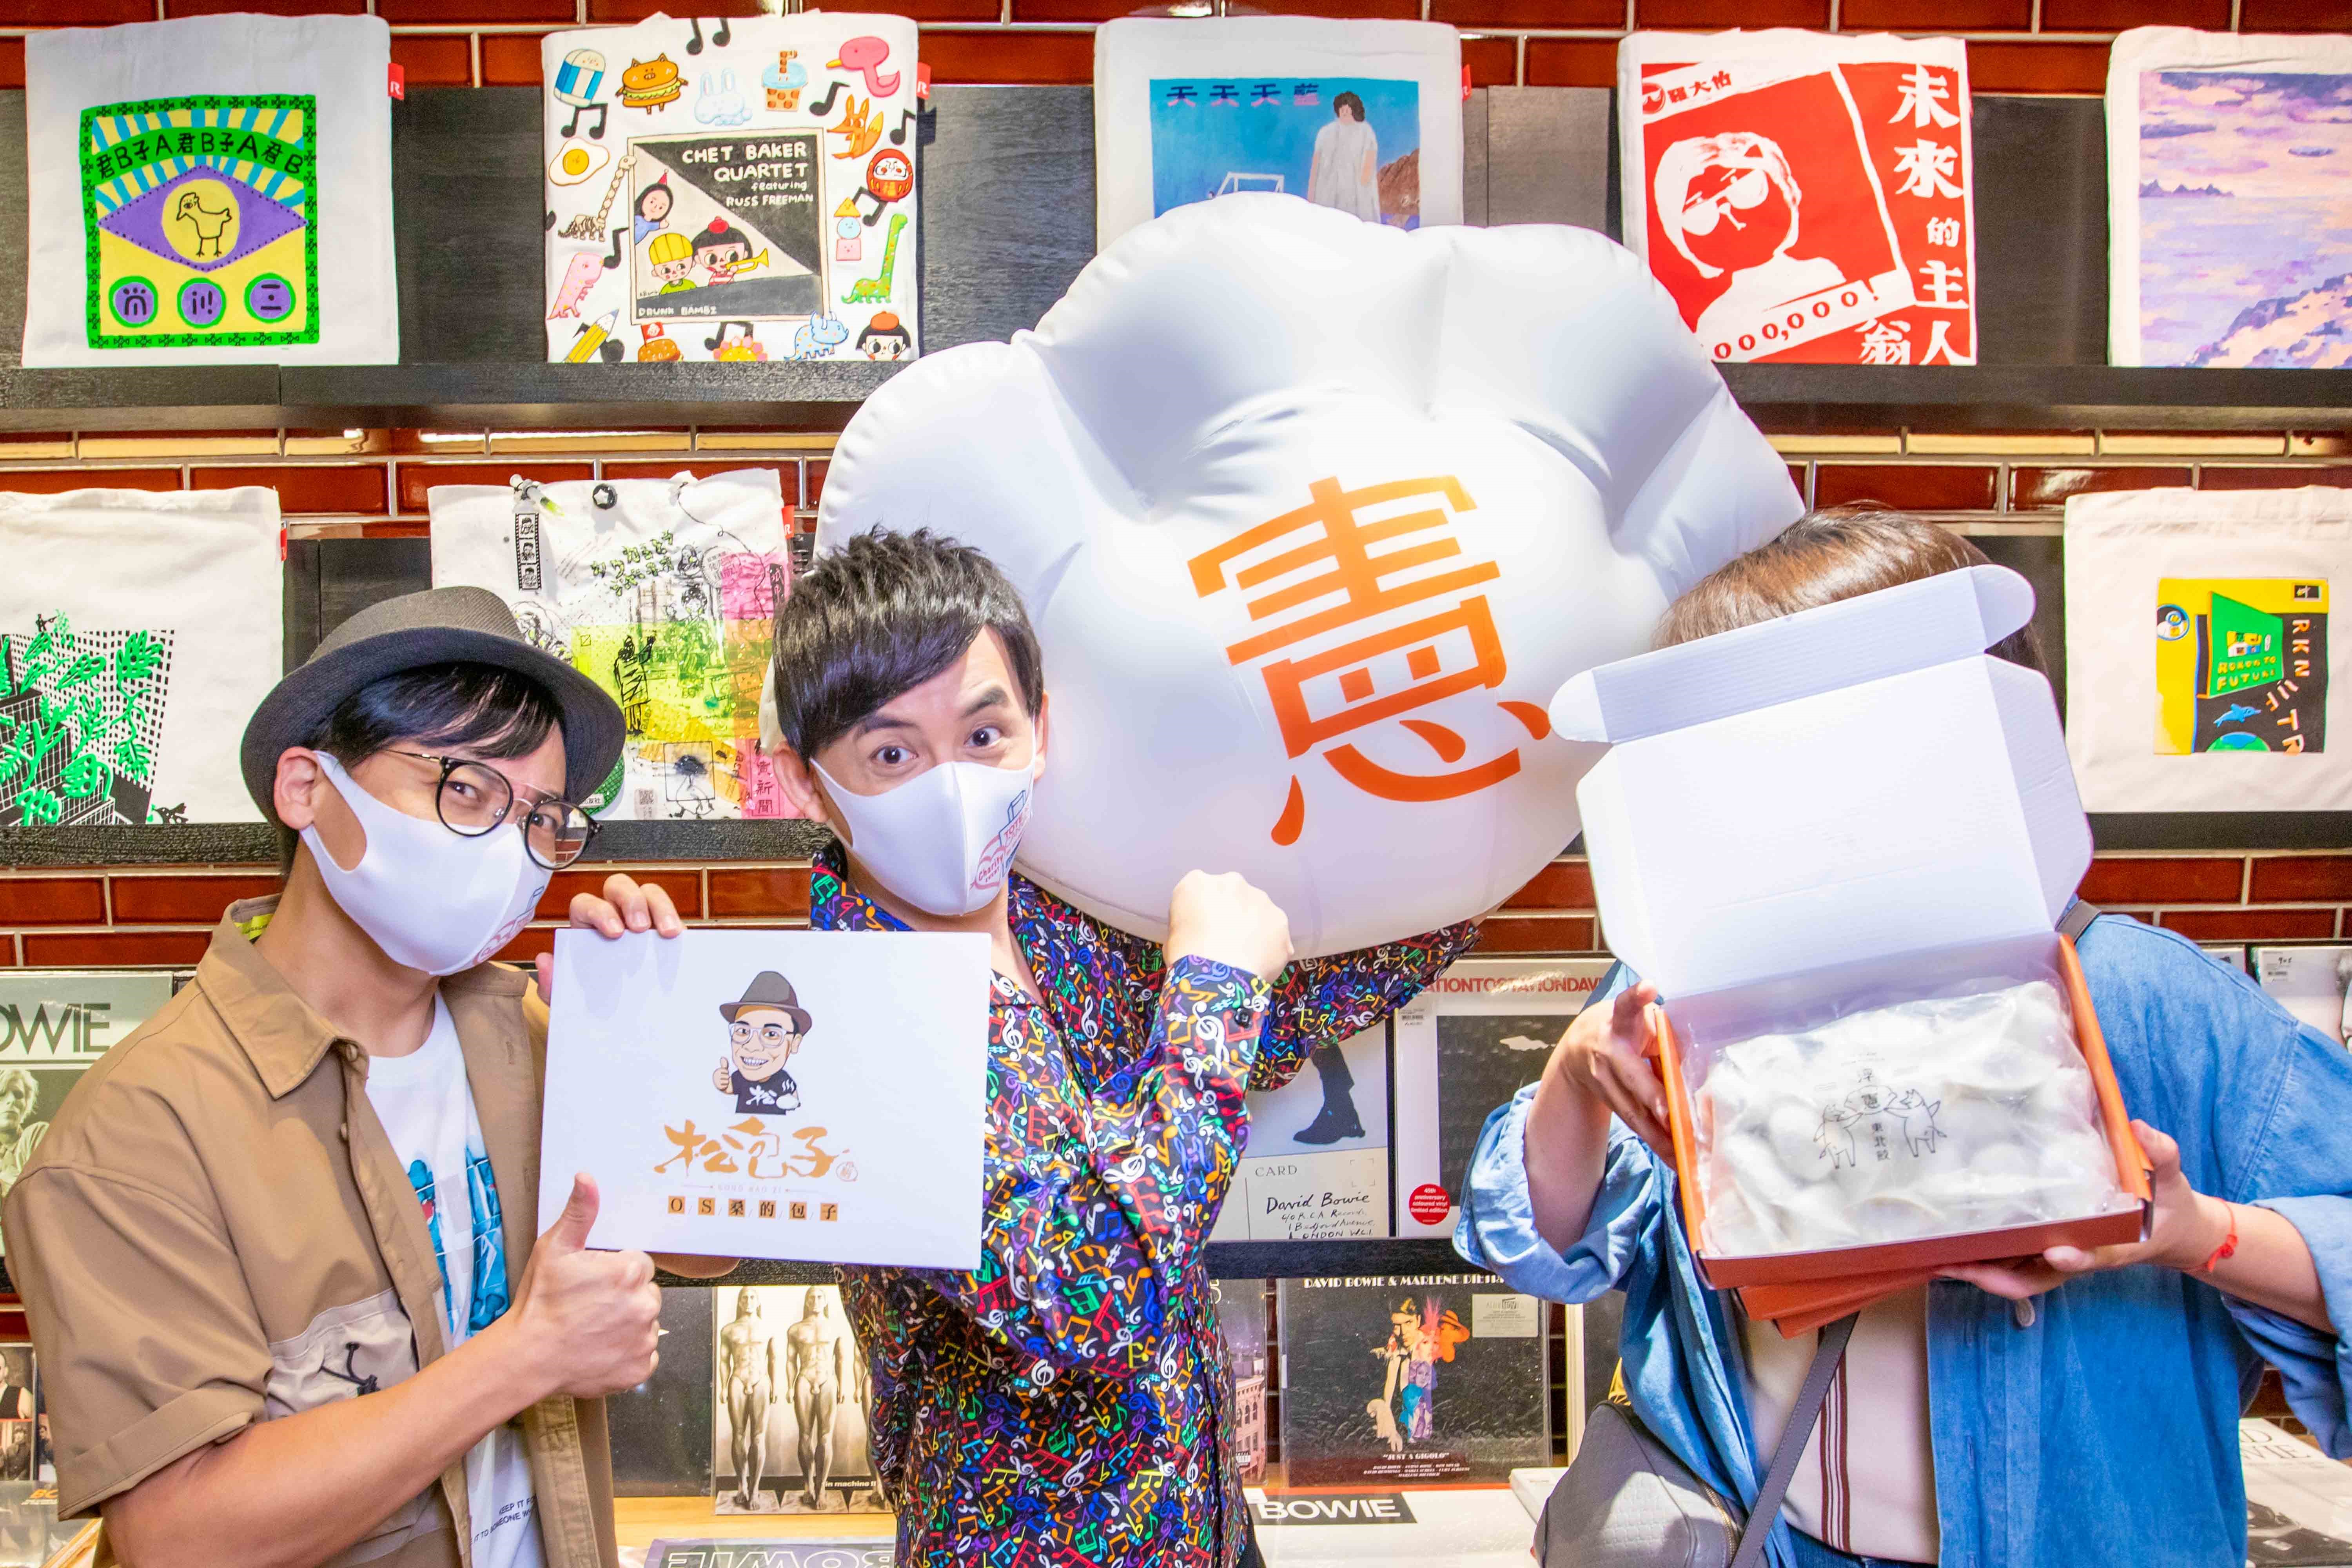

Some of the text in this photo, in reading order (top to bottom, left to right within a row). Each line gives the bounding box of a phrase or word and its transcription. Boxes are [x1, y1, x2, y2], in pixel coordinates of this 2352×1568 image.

[682, 141, 807, 164] CHET BAKER
[713, 163, 809, 182] QUARTET
[751, 181, 808, 192] featuring
[726, 194, 814, 207] RUSS FREEMAN
[1187, 474, 1551, 846] 憲
[1255, 1165, 1298, 1177] CARD
[1267, 1191, 1370, 1214] David Bowie
[1304, 1277, 1341, 1289] DAVID
[1345, 1276, 1385, 1288] BOWIE
[1388, 1276, 1397, 1287] &
[1399, 1275, 1461, 1286] MARLENE
[1257, 1499, 1401, 1519] BOWIE
